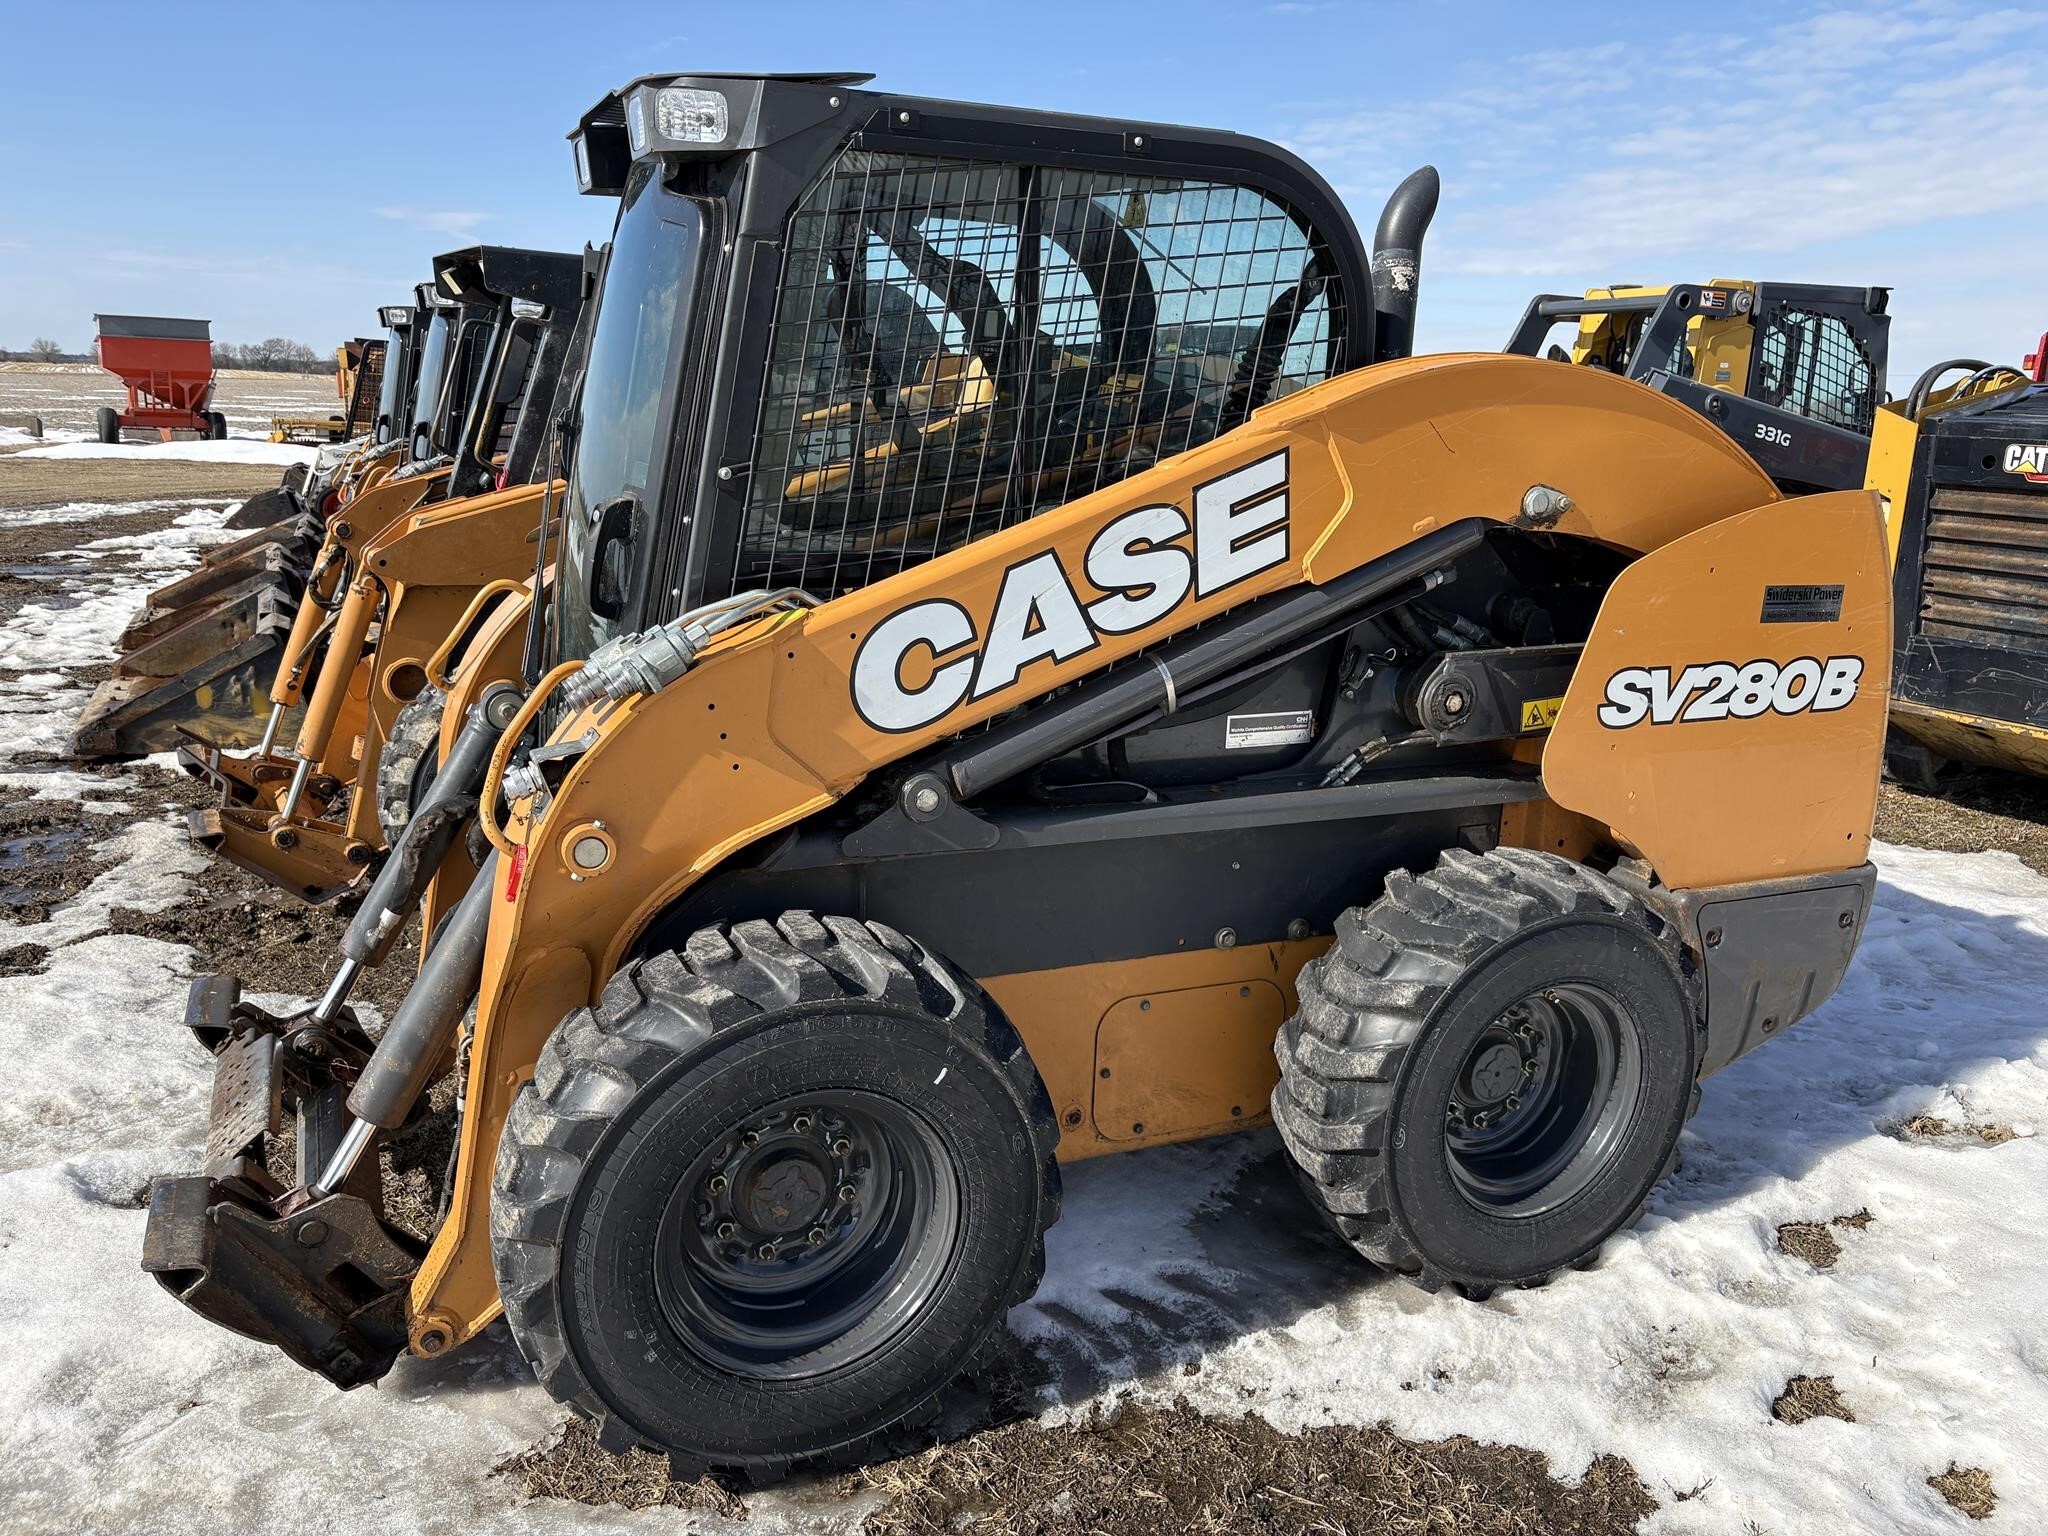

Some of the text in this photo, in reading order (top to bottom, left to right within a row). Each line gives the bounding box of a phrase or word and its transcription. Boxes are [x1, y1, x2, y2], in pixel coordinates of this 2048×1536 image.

[1755, 424, 1792, 447] 331G
[2004, 444, 2048, 474] CAT
[850, 447, 1290, 734] CASE
[1766, 588, 1843, 601] Swiderski Power
[1598, 655, 1865, 730] SV280B
